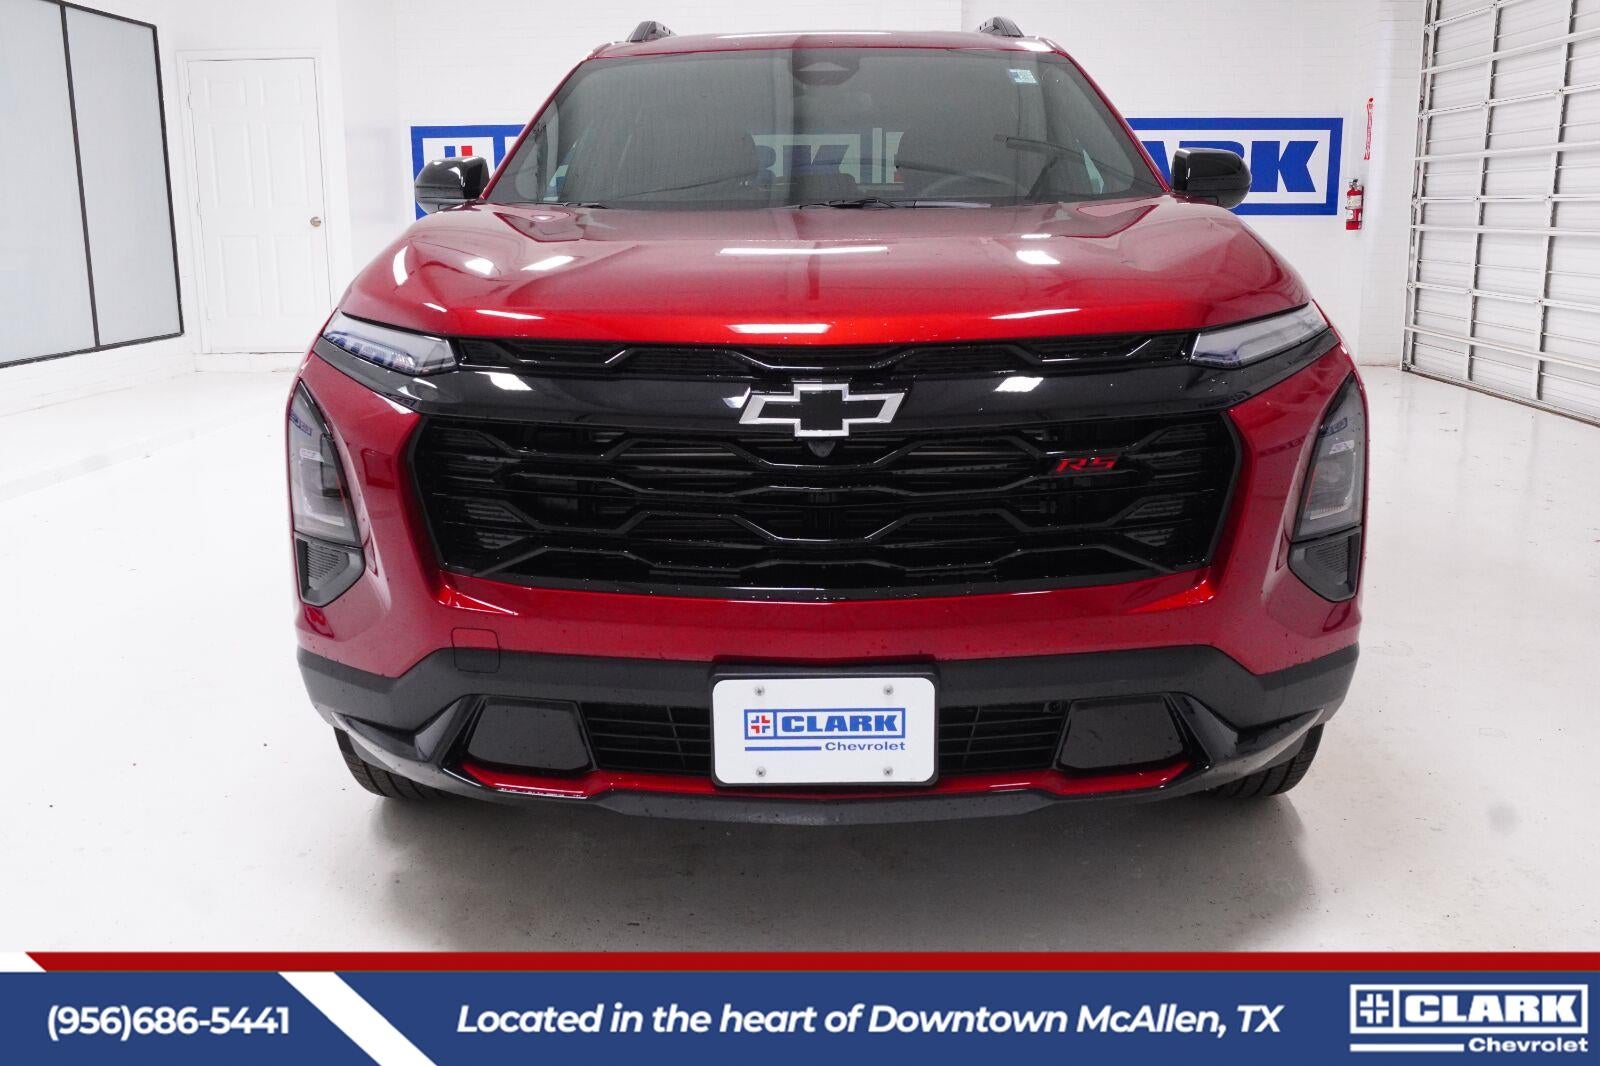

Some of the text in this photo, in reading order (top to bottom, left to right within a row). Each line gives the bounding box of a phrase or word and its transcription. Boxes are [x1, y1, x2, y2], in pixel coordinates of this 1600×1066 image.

[1056, 456, 1118, 473] RS
[782, 714, 897, 733] CLARK
[825, 741, 906, 751] Chevrolet
